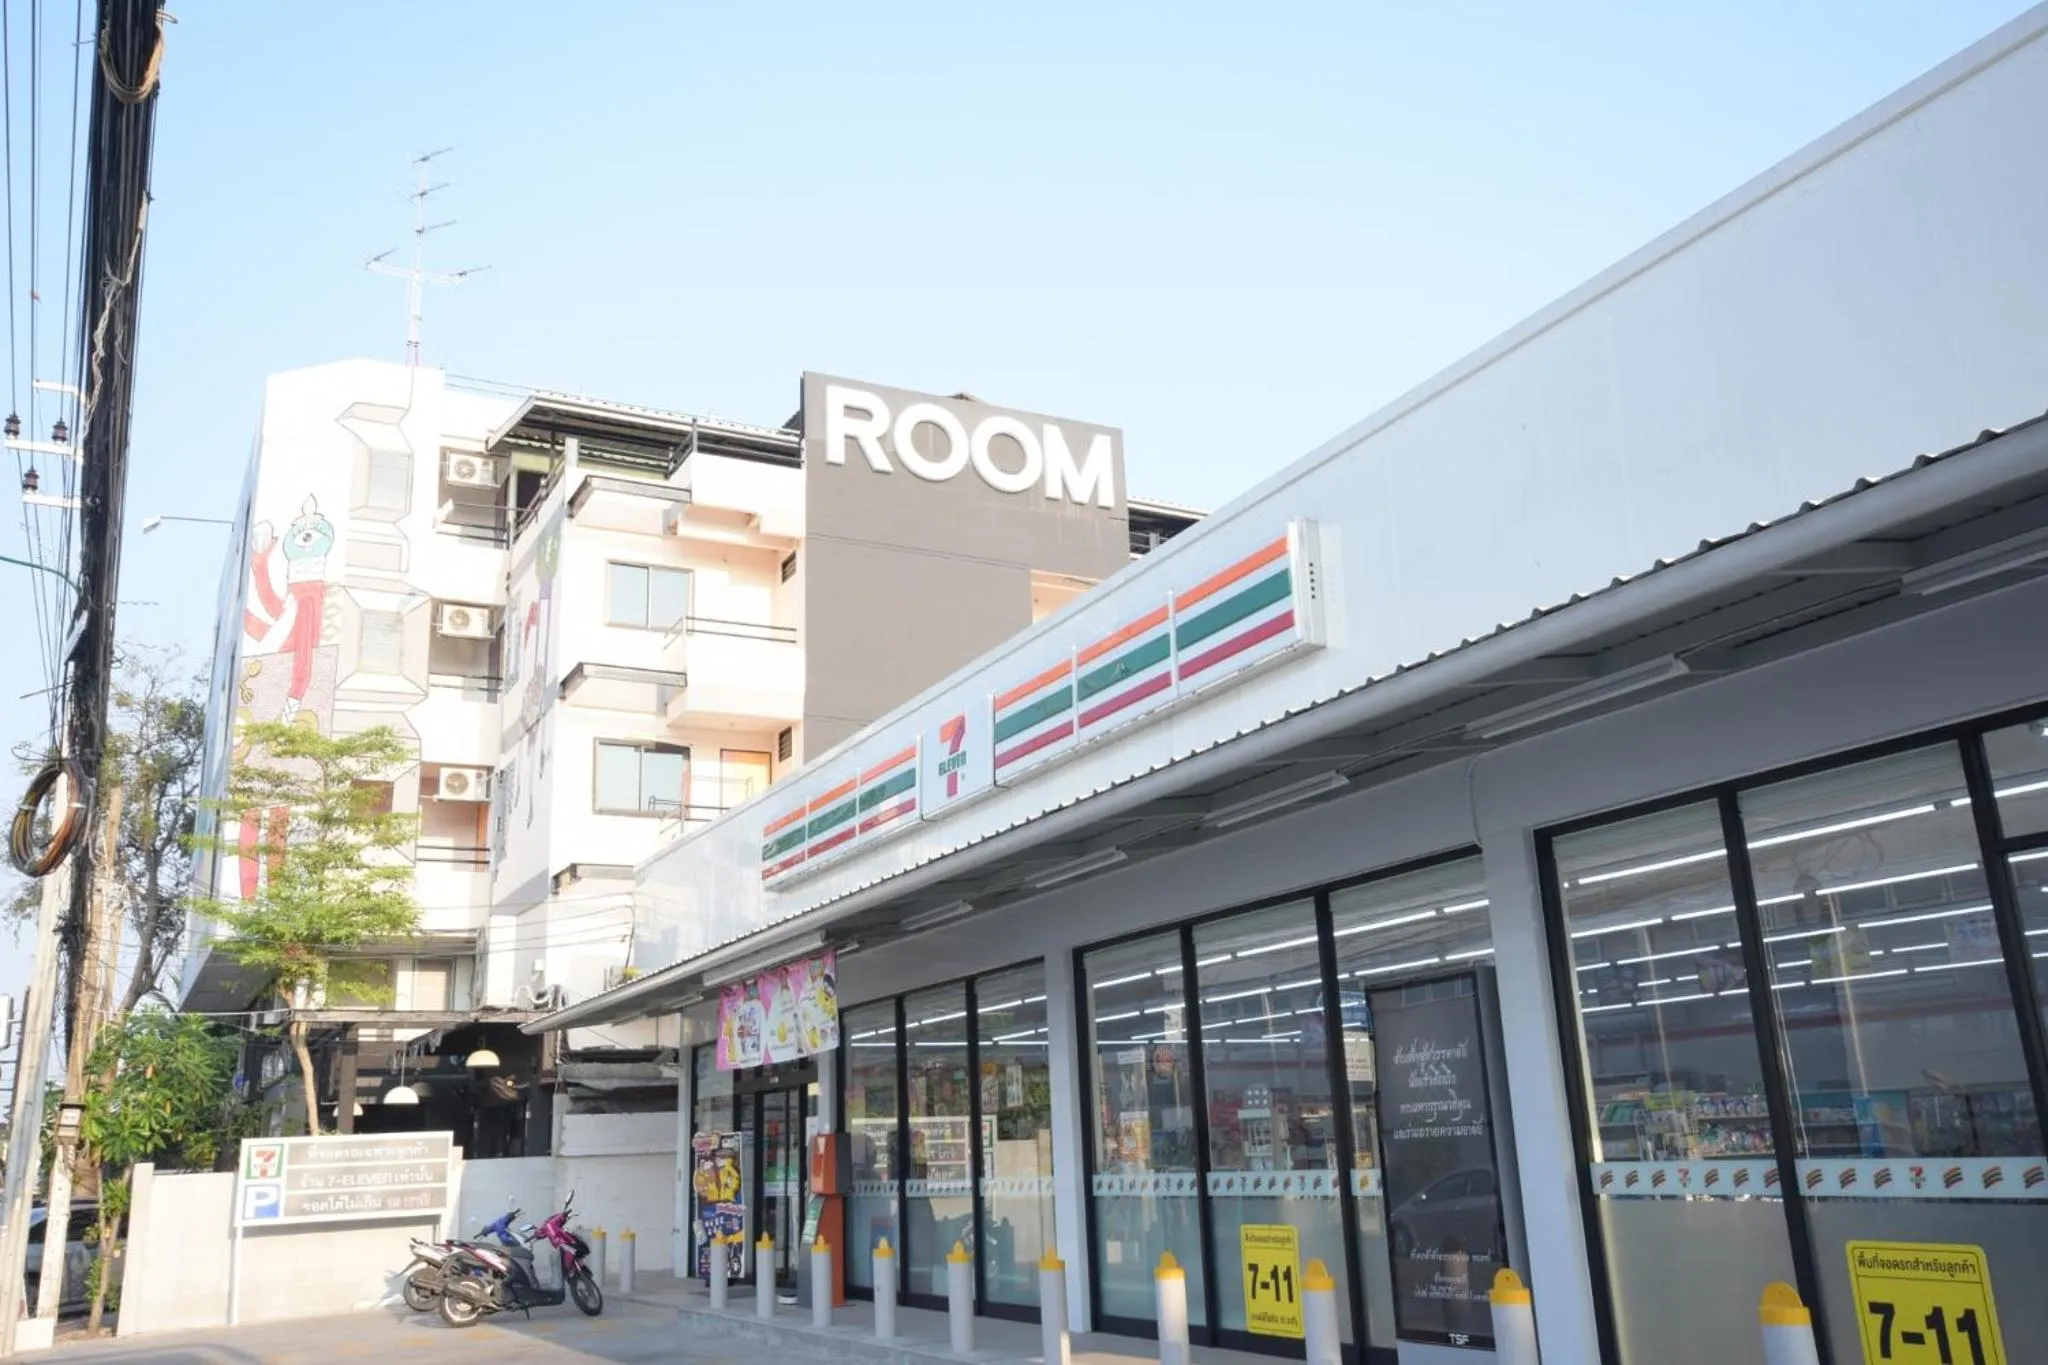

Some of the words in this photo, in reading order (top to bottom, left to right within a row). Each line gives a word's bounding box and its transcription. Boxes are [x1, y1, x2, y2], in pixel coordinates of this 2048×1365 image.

[825, 385, 1115, 508] ROOM
[246, 1184, 279, 1219] P
[1248, 1263, 1294, 1303] 7-11
[1868, 1301, 1986, 1365] 7-11
